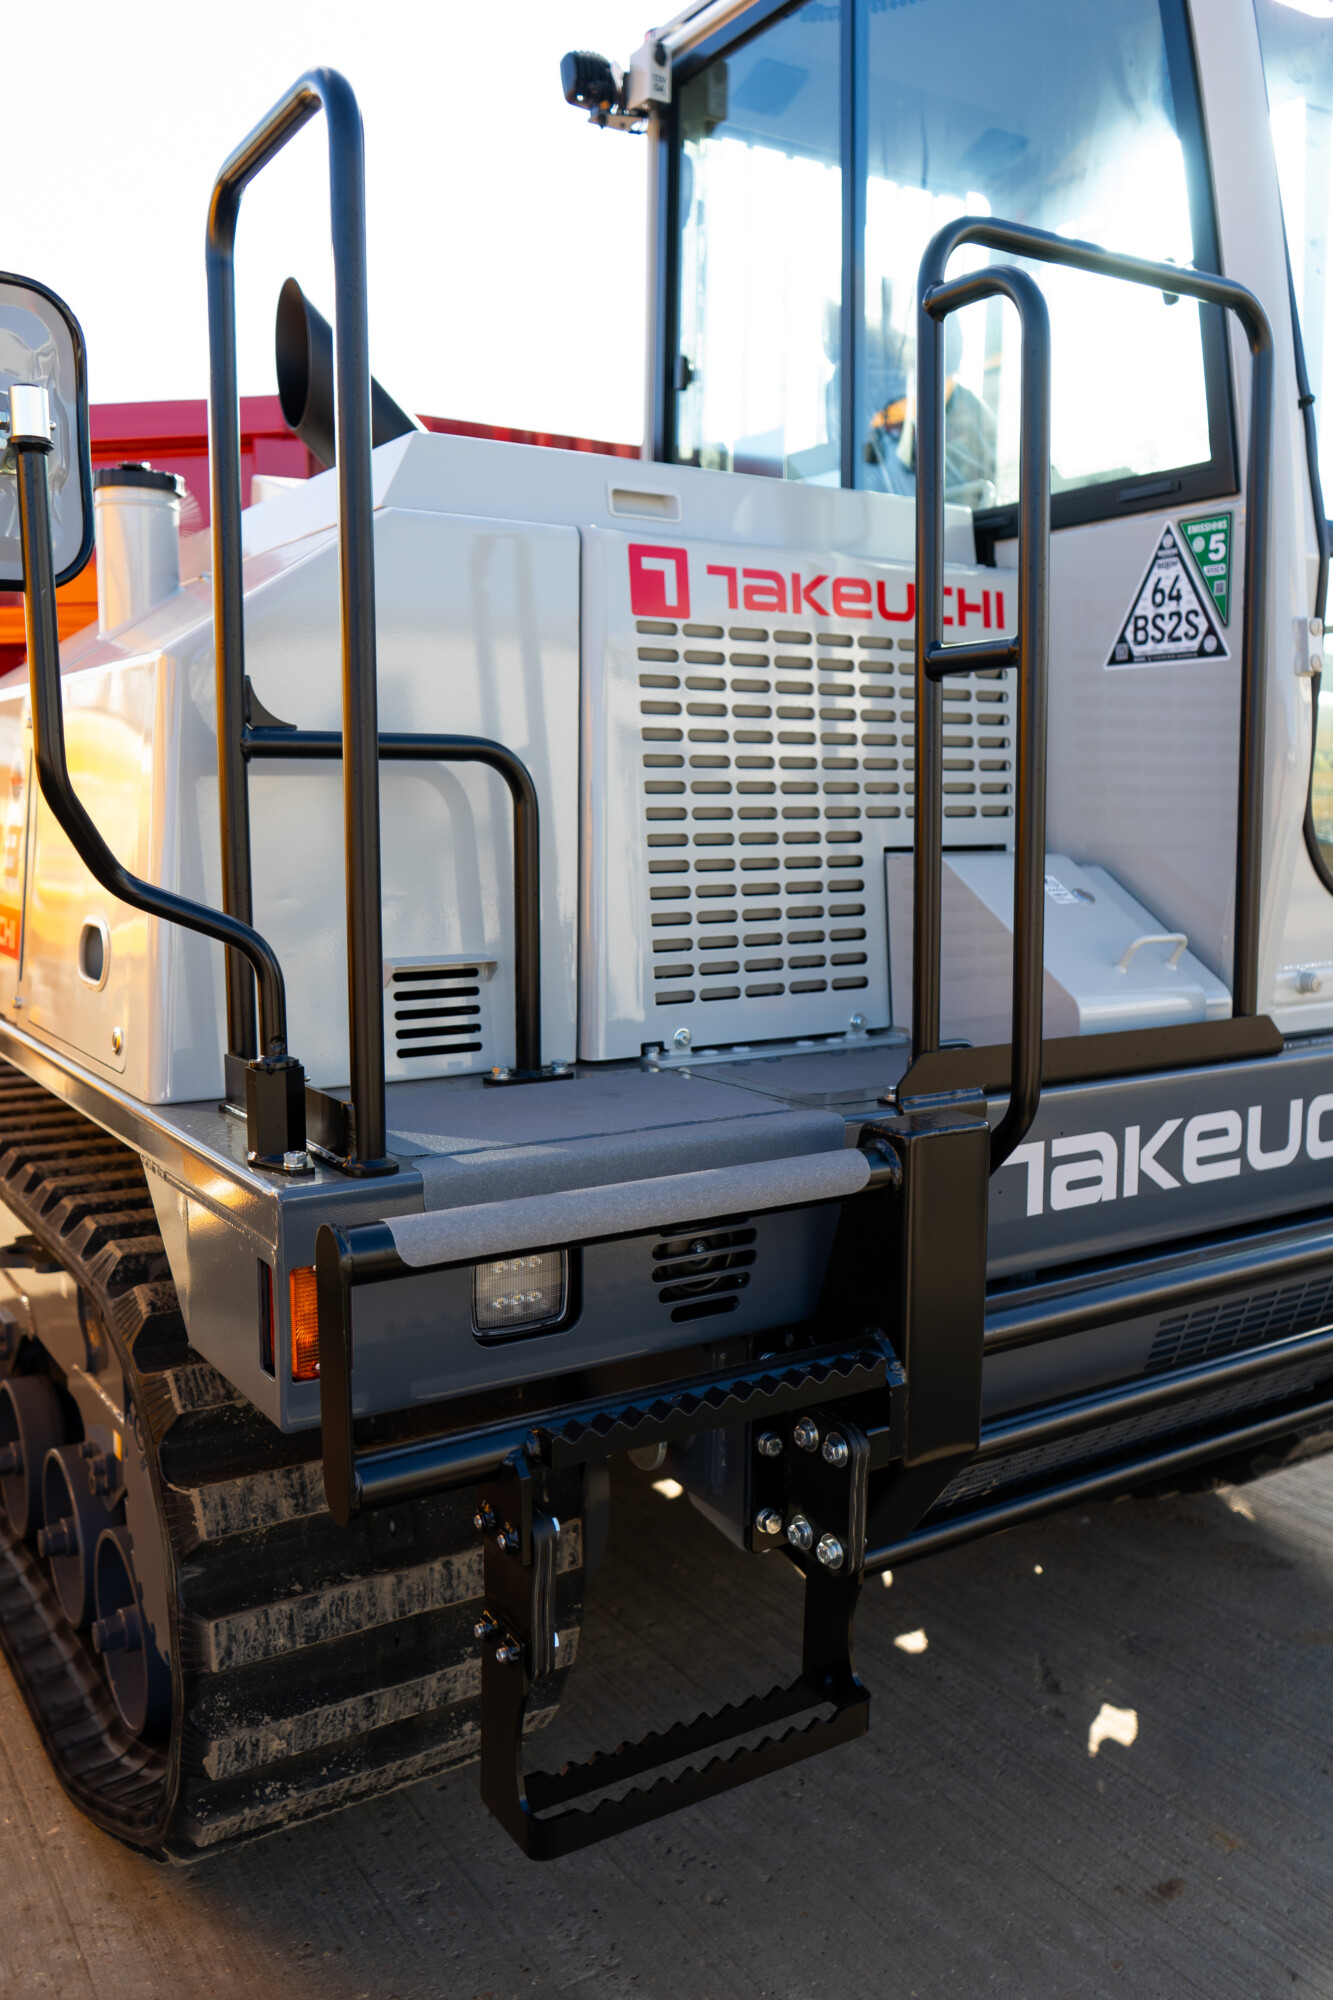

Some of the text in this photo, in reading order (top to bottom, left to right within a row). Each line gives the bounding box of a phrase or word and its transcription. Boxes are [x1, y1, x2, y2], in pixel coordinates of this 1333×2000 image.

[1208, 532, 1226, 561] 5
[1152, 574, 1182, 608] 64
[1133, 609, 1199, 645] BS2S
